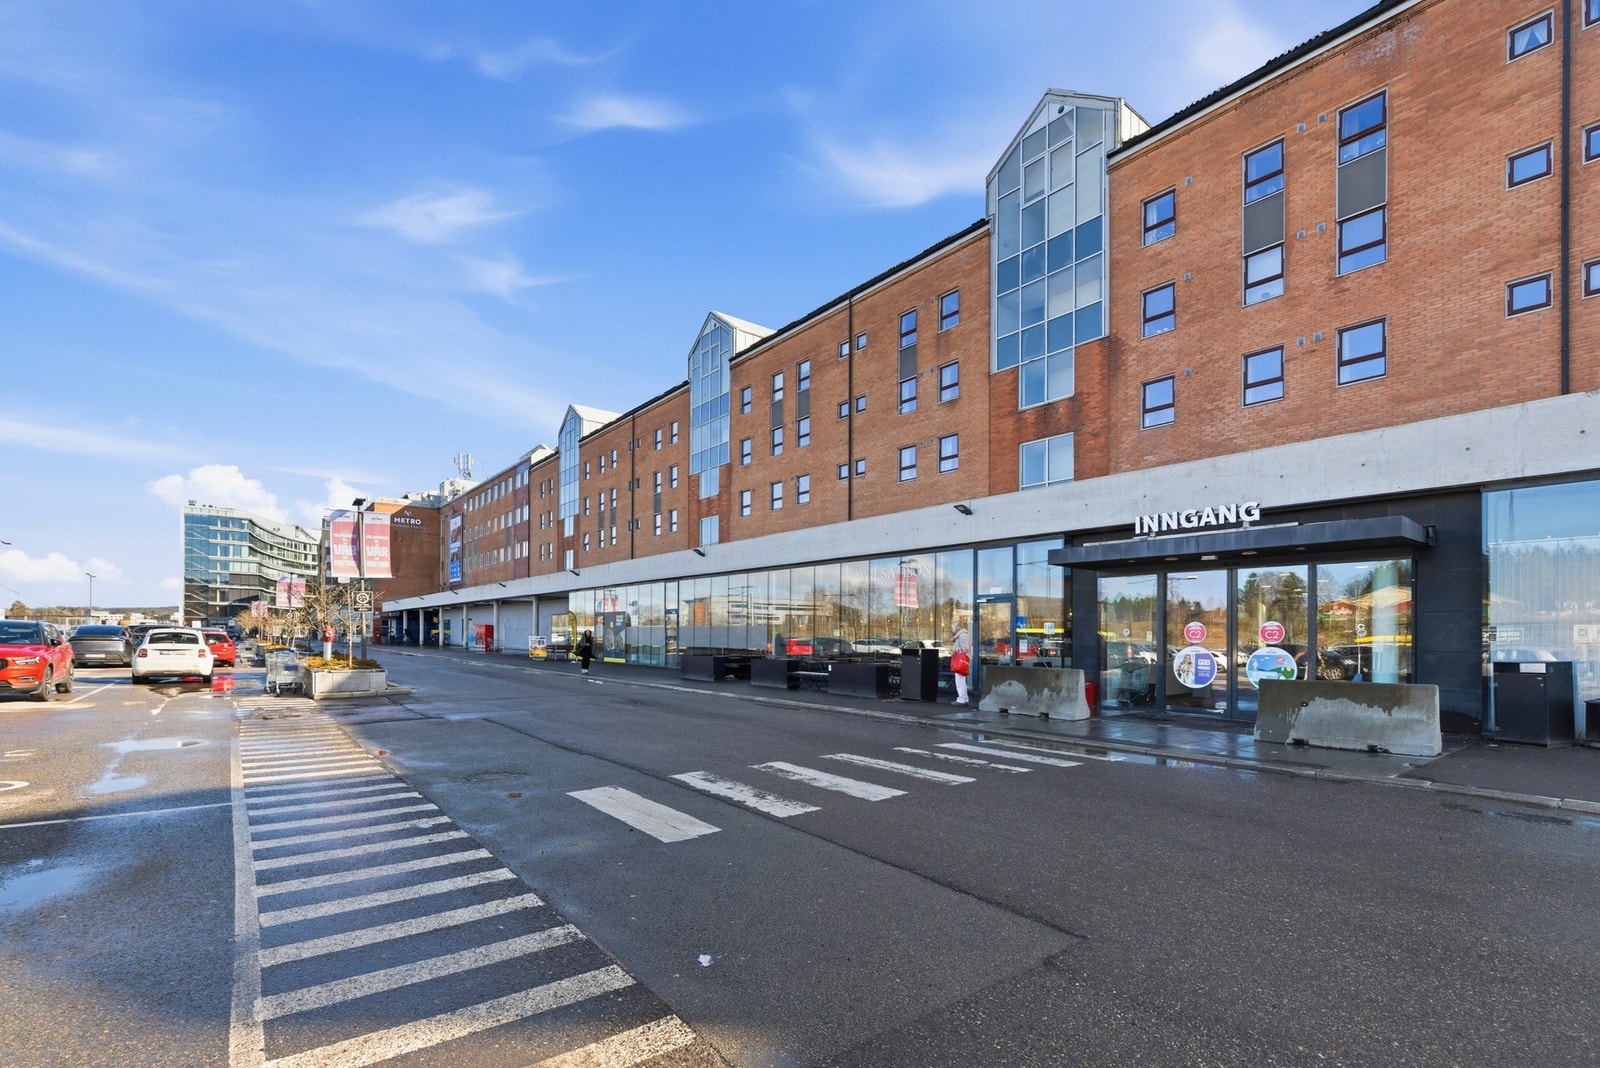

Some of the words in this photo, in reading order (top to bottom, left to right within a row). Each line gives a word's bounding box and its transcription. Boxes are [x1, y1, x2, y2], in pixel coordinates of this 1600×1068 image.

[394, 517, 421, 525] METRO
[1135, 501, 1260, 534] INNGANG
[366, 543, 389, 557] VÅR
[1189, 630, 1201, 639] C2
[1265, 630, 1279, 639] C2
